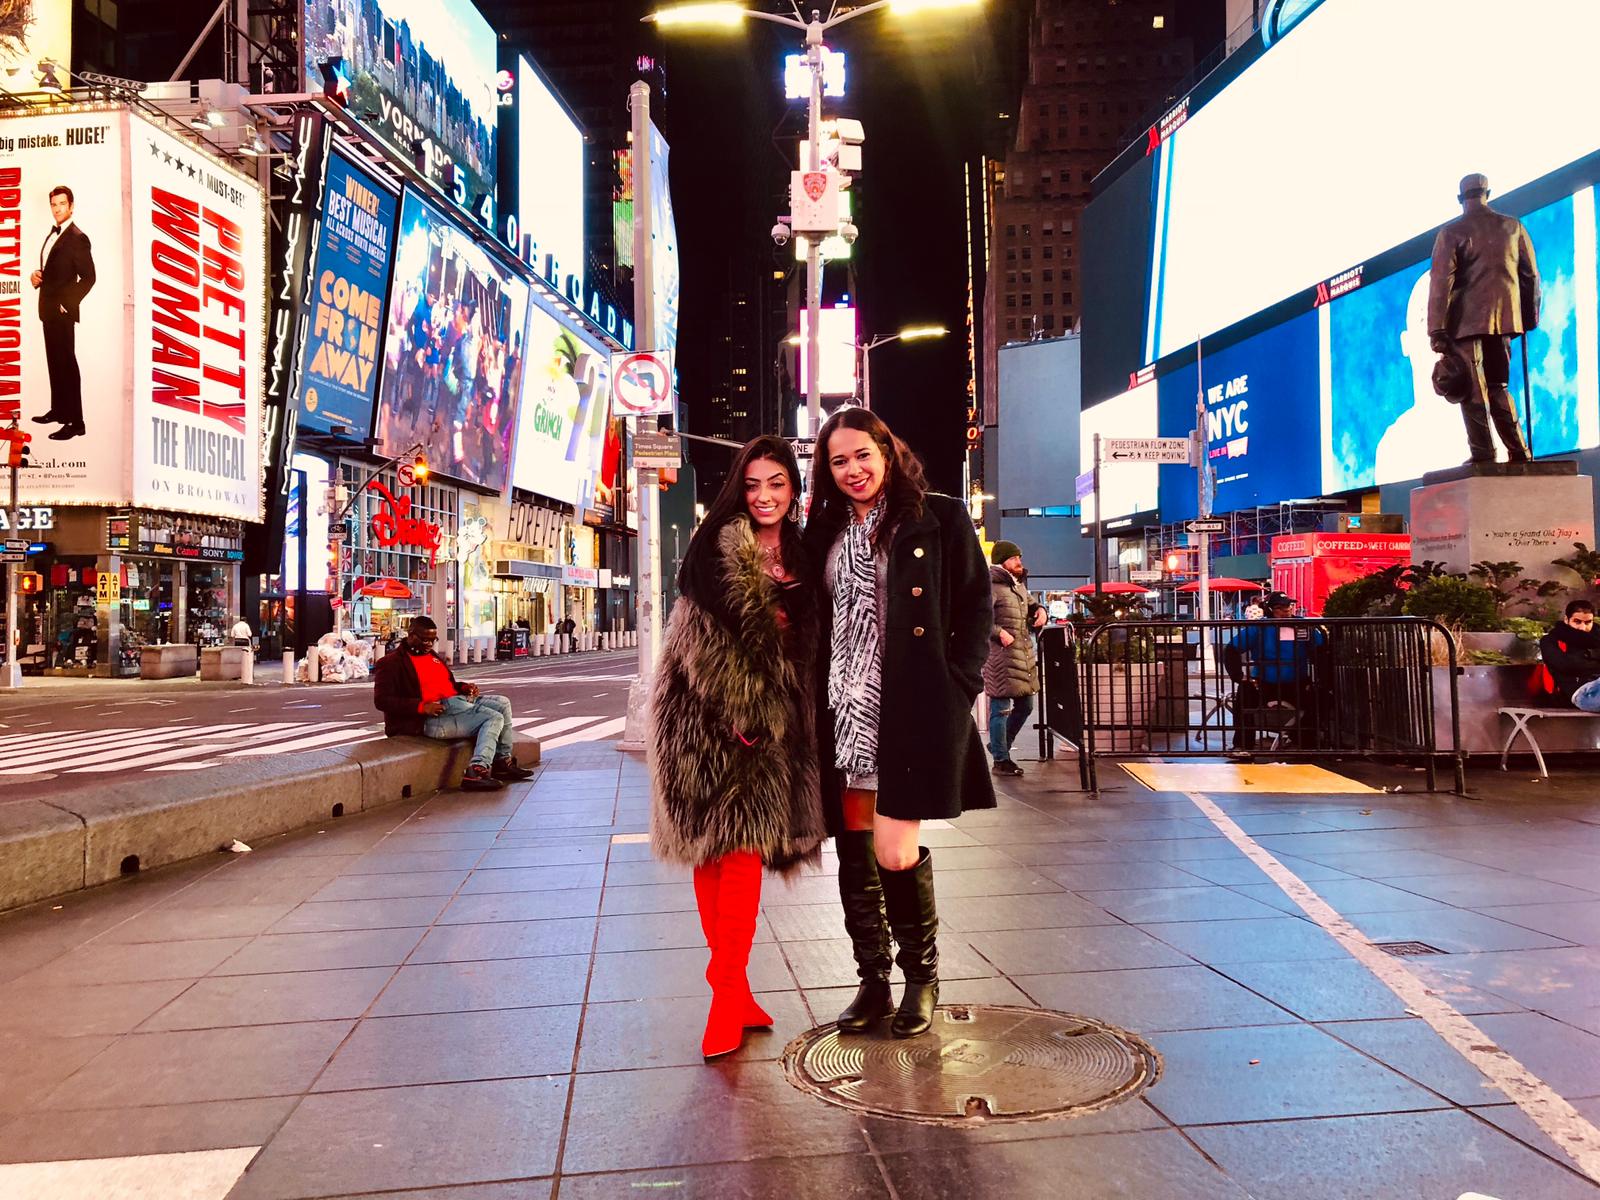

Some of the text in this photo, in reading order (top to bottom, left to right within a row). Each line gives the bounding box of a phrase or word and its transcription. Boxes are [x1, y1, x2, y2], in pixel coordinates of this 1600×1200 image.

[85, 72, 141, 90] LAMAR
[1160, 96, 1190, 128] MARRIOTT
[1160, 111, 1188, 142] MARQUIS
[0, 135, 14, 152] big
[18, 135, 62, 149] mistake.
[346, 174, 380, 218] WINNER!
[328, 189, 387, 251] BEST MUSICAL
[325, 215, 336, 232] ALL
[335, 221, 354, 243] ACROSS
[354, 234, 368, 253] NORTH
[367, 242, 386, 264] AMERICA
[1330, 265, 1364, 287] MARRIOTT
[1330, 277, 1361, 297] MARQUIS
[151, 185, 201, 415] WOMAN
[319, 269, 381, 325] COME
[201, 206, 247, 435] PRETTY
[308, 340, 375, 394] AWAY
[1207, 374, 1249, 405] WE ARE
[534, 403, 563, 441] GRINCH
[1207, 400, 1249, 442] NYC
[151, 416, 246, 481] THE MUSICAL
[791, 444, 809, 453] ONE
[1111, 440, 1185, 449] PEDESTRIAN FLOW ZONE
[1144, 451, 1186, 460] KEEP MOVING
[151, 479, 247, 505] ON BROADWAY
[1277, 540, 1306, 553] COFFEED
[1317, 540, 1364, 551] COFFEED
[1368, 541, 1387, 551] SWEET
[1519, 529, 1542, 538] Grand
[1543, 529, 1556, 537] Old
[176, 546, 199, 557] Canon
[202, 548, 225, 558] SONY
[99, 574, 108, 599] ATM
[111, 574, 119, 599] ATM
